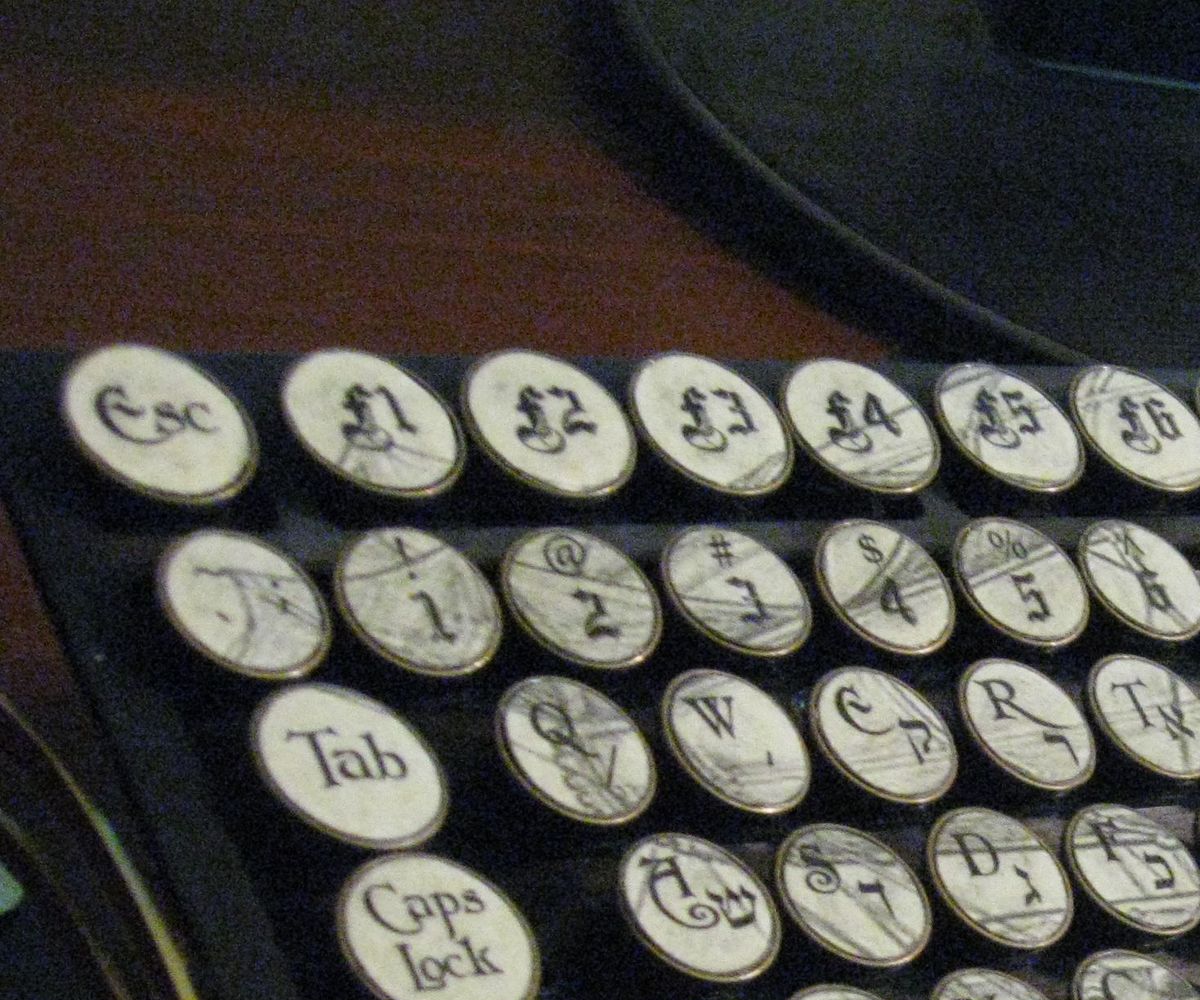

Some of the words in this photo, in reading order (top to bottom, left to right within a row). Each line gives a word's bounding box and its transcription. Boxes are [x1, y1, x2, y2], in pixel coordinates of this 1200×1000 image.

[94, 384, 221, 446] Esc
[542, 532, 587, 577] @
[709, 532, 735, 569] #
[857, 532, 885, 565] $
[987, 528, 1030, 560] %
[407, 590, 457, 644] 1
[570, 587, 621, 640] 2
[879, 577, 918, 627] 4
[1008, 571, 1051, 624] 5
[530, 701, 600, 759] Q
[681, 695, 736, 740] W
[973, 677, 1073, 731] R
[1110, 678, 1157, 729] T
[285, 724, 409, 789] Tab
[798, 842, 842, 895] S
[952, 832, 1000, 877] D
[363, 882, 486, 943] Caps
[638, 855, 720, 930] A
[396, 937, 504, 993] Lock
